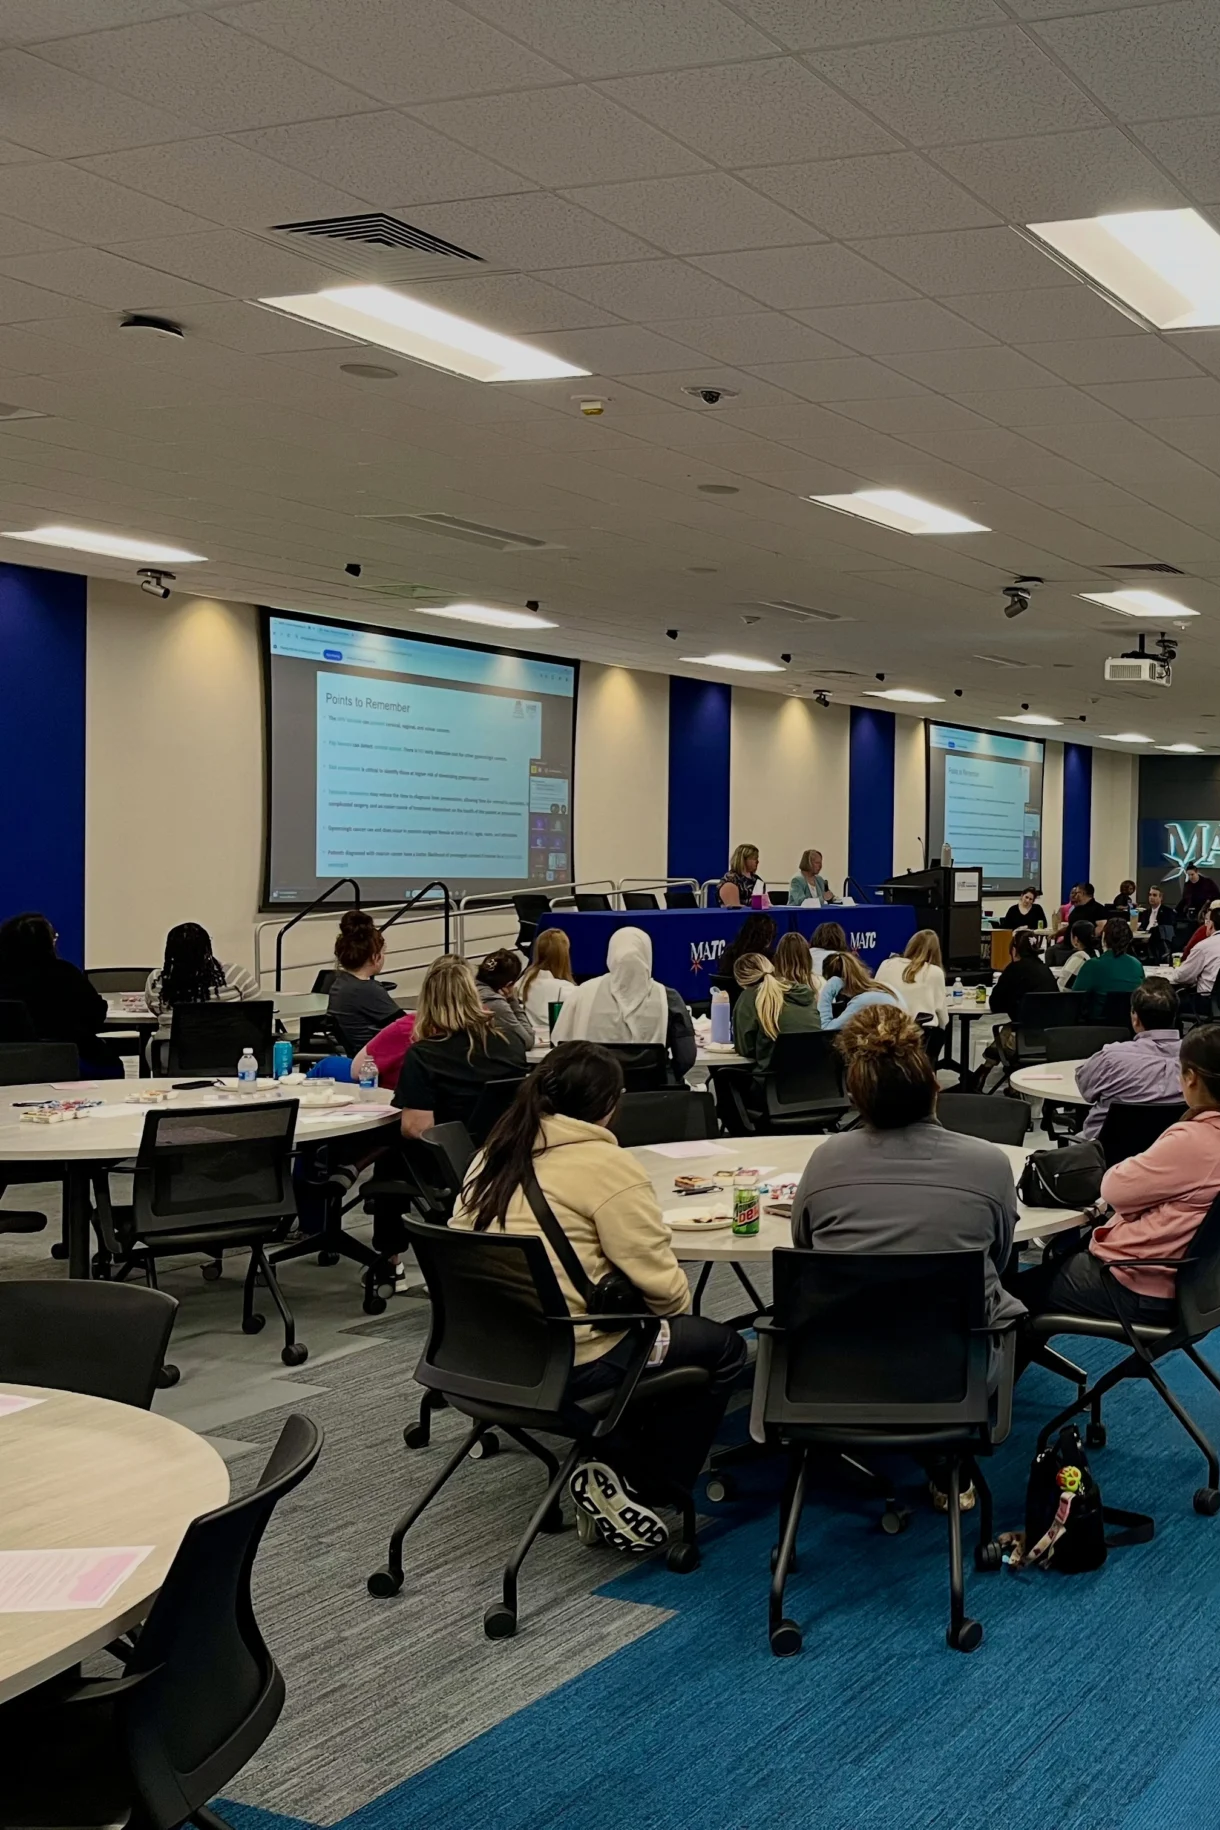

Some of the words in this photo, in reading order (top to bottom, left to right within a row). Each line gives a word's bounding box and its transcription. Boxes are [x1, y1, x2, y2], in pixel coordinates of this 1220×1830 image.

[326, 692, 353, 706] Points
[355, 697, 363, 708] to
[365, 697, 411, 713] Remember
[690, 939, 726, 961] MATC
[850, 931, 876, 949] MATC
